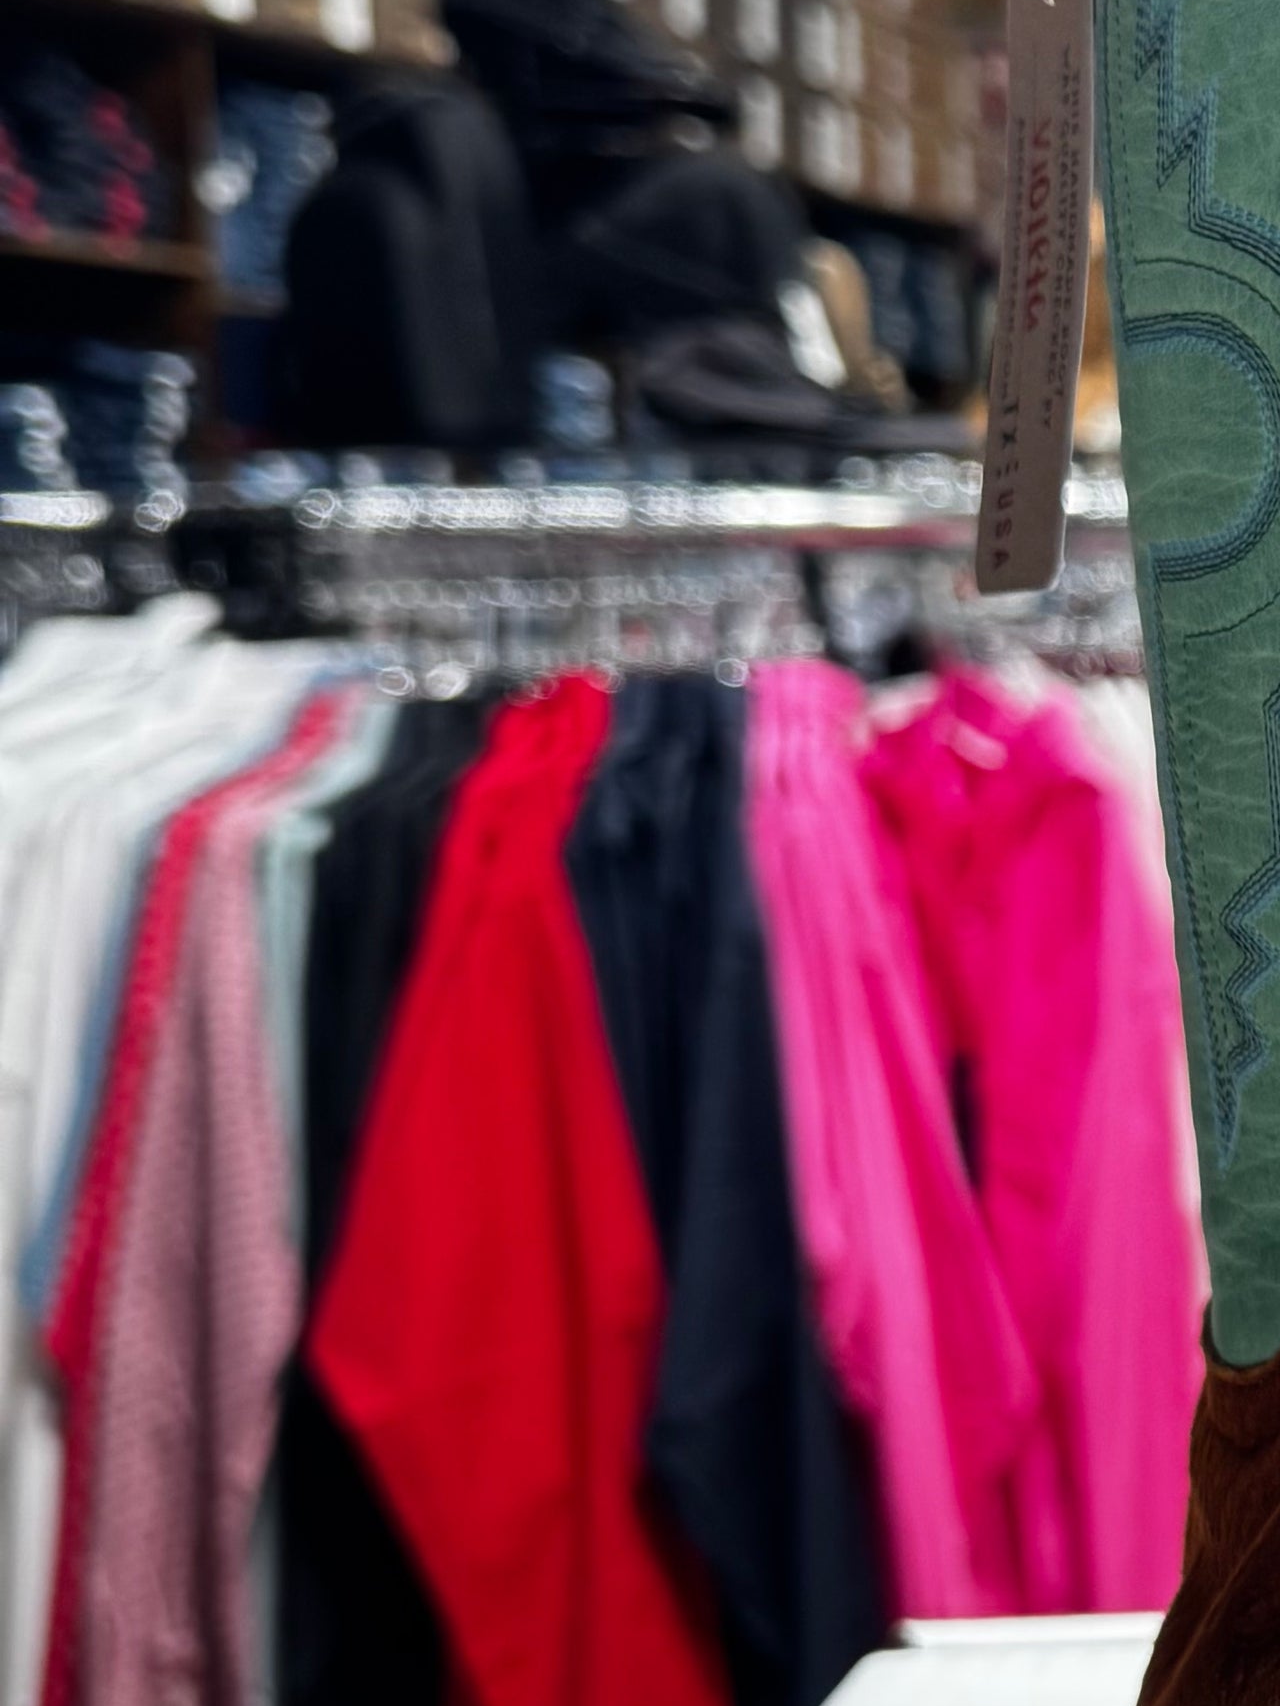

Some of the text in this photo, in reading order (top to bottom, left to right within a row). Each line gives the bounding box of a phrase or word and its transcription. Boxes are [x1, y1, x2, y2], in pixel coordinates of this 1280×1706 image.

[1057, 119, 1070, 240] QUALITY
[1063, 150, 1080, 309] HANDMADE
[1048, 253, 1065, 384] CHECKED
[992, 487, 1014, 572] USA
